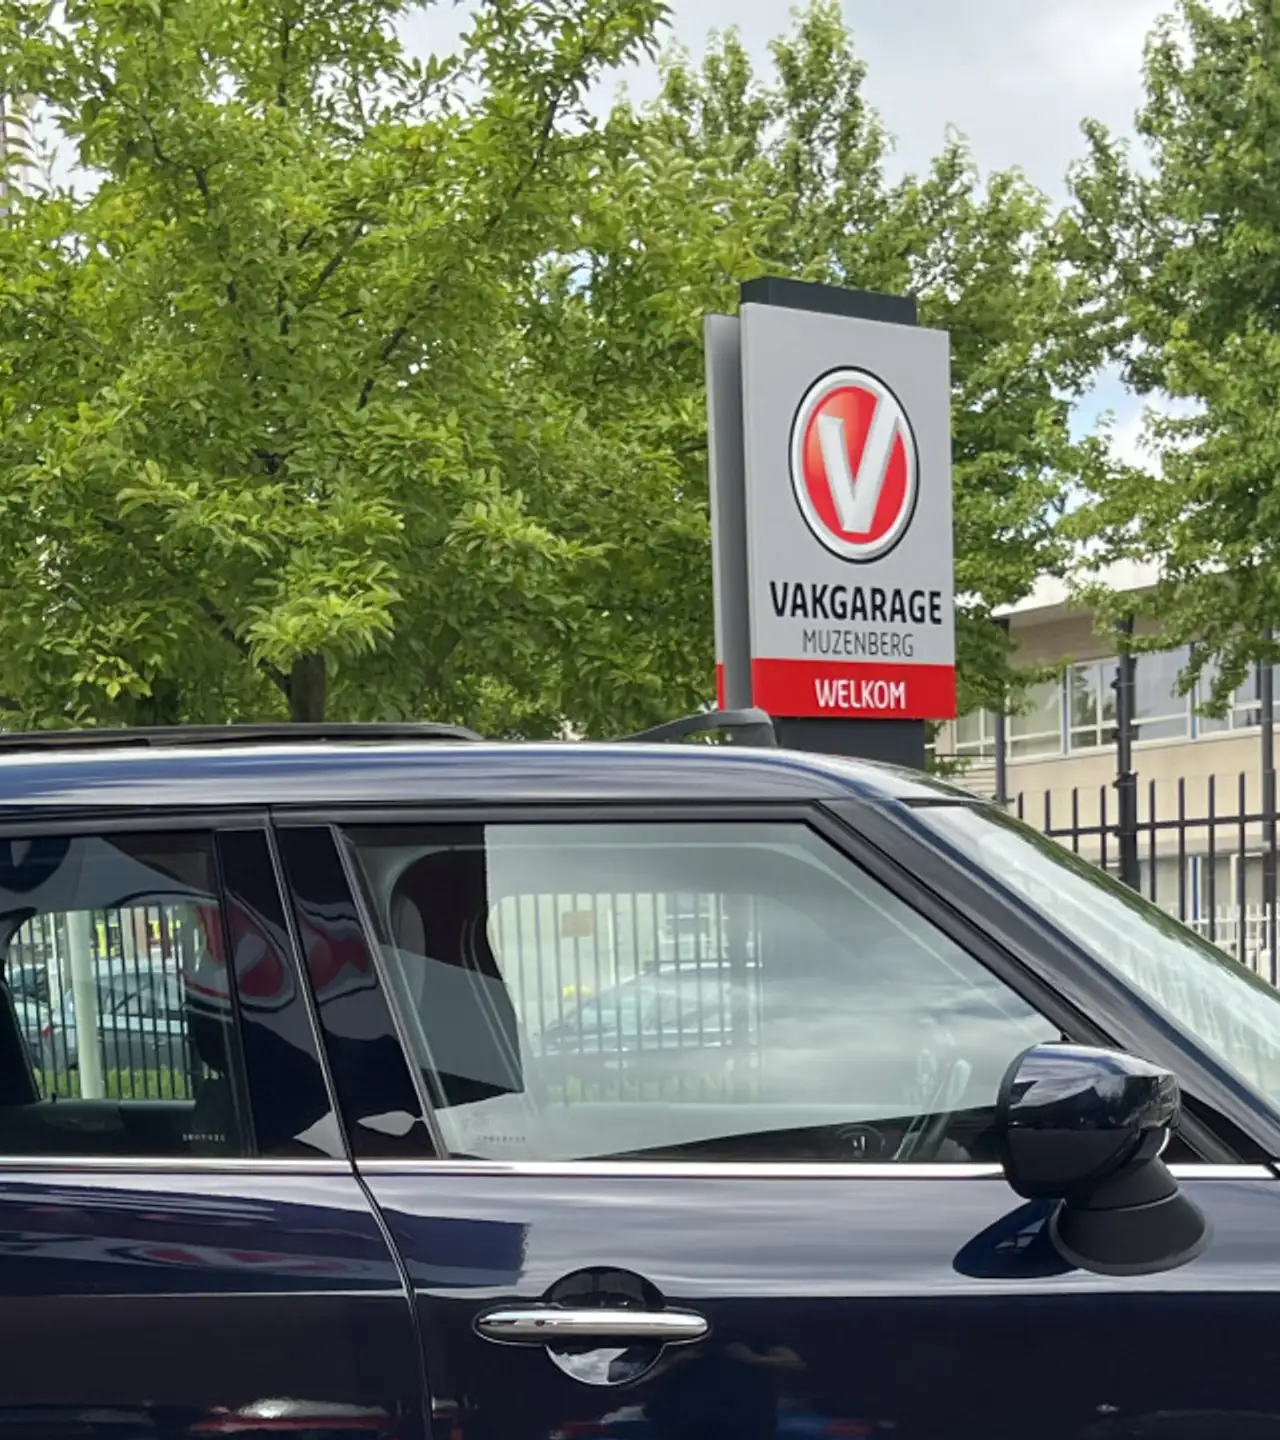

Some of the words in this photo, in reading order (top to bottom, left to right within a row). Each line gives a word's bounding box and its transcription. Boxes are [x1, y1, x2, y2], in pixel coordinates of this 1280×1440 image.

[769, 580, 943, 626] VAKGARAGE
[802, 628, 915, 658] MUZENBERG
[814, 677, 907, 710] WELKOM
